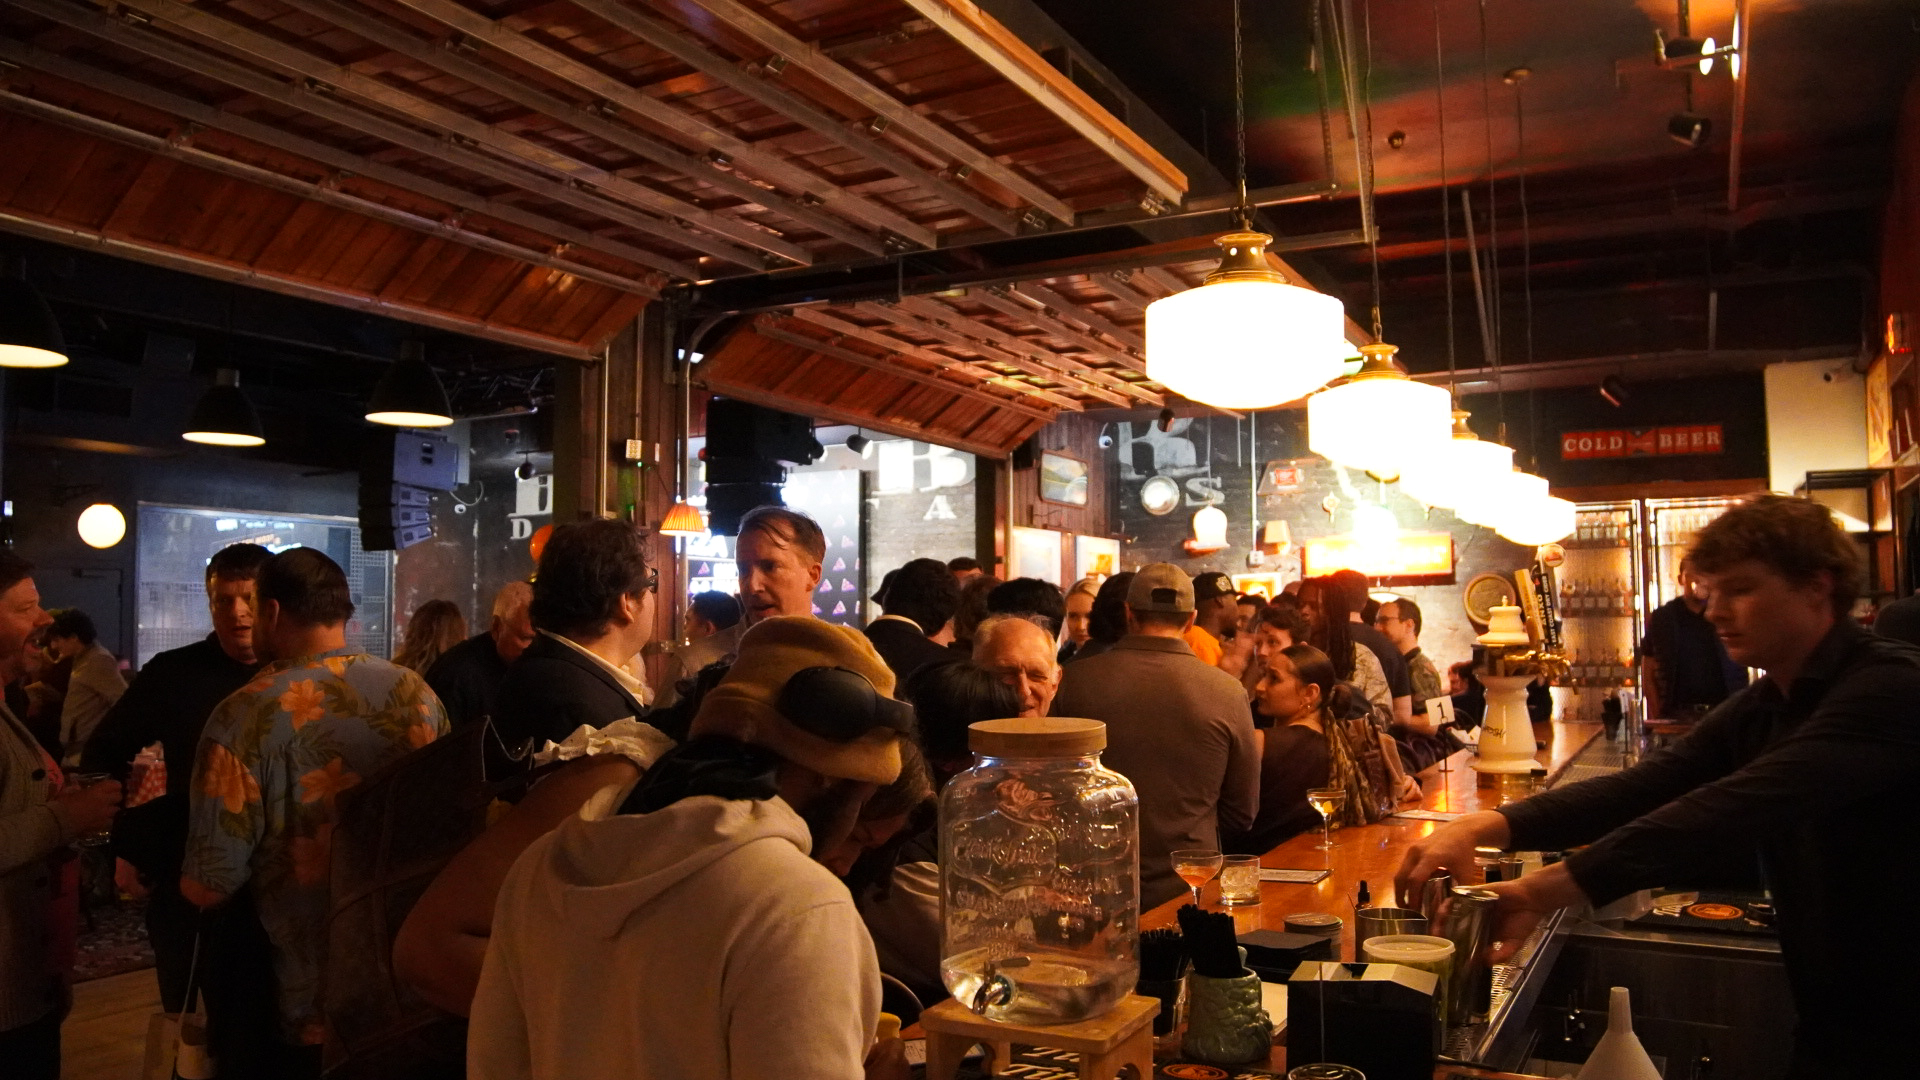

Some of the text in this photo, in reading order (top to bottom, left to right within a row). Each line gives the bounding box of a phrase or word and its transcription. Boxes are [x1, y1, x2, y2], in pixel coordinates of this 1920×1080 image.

[1564, 436, 1623, 452] COLD
[1658, 431, 1720, 448] BEER
[922, 495, 957, 521] A
[510, 518, 532, 540] D
[1537, 594, 1547, 626] ANXO
[1437, 702, 1445, 718] 1
